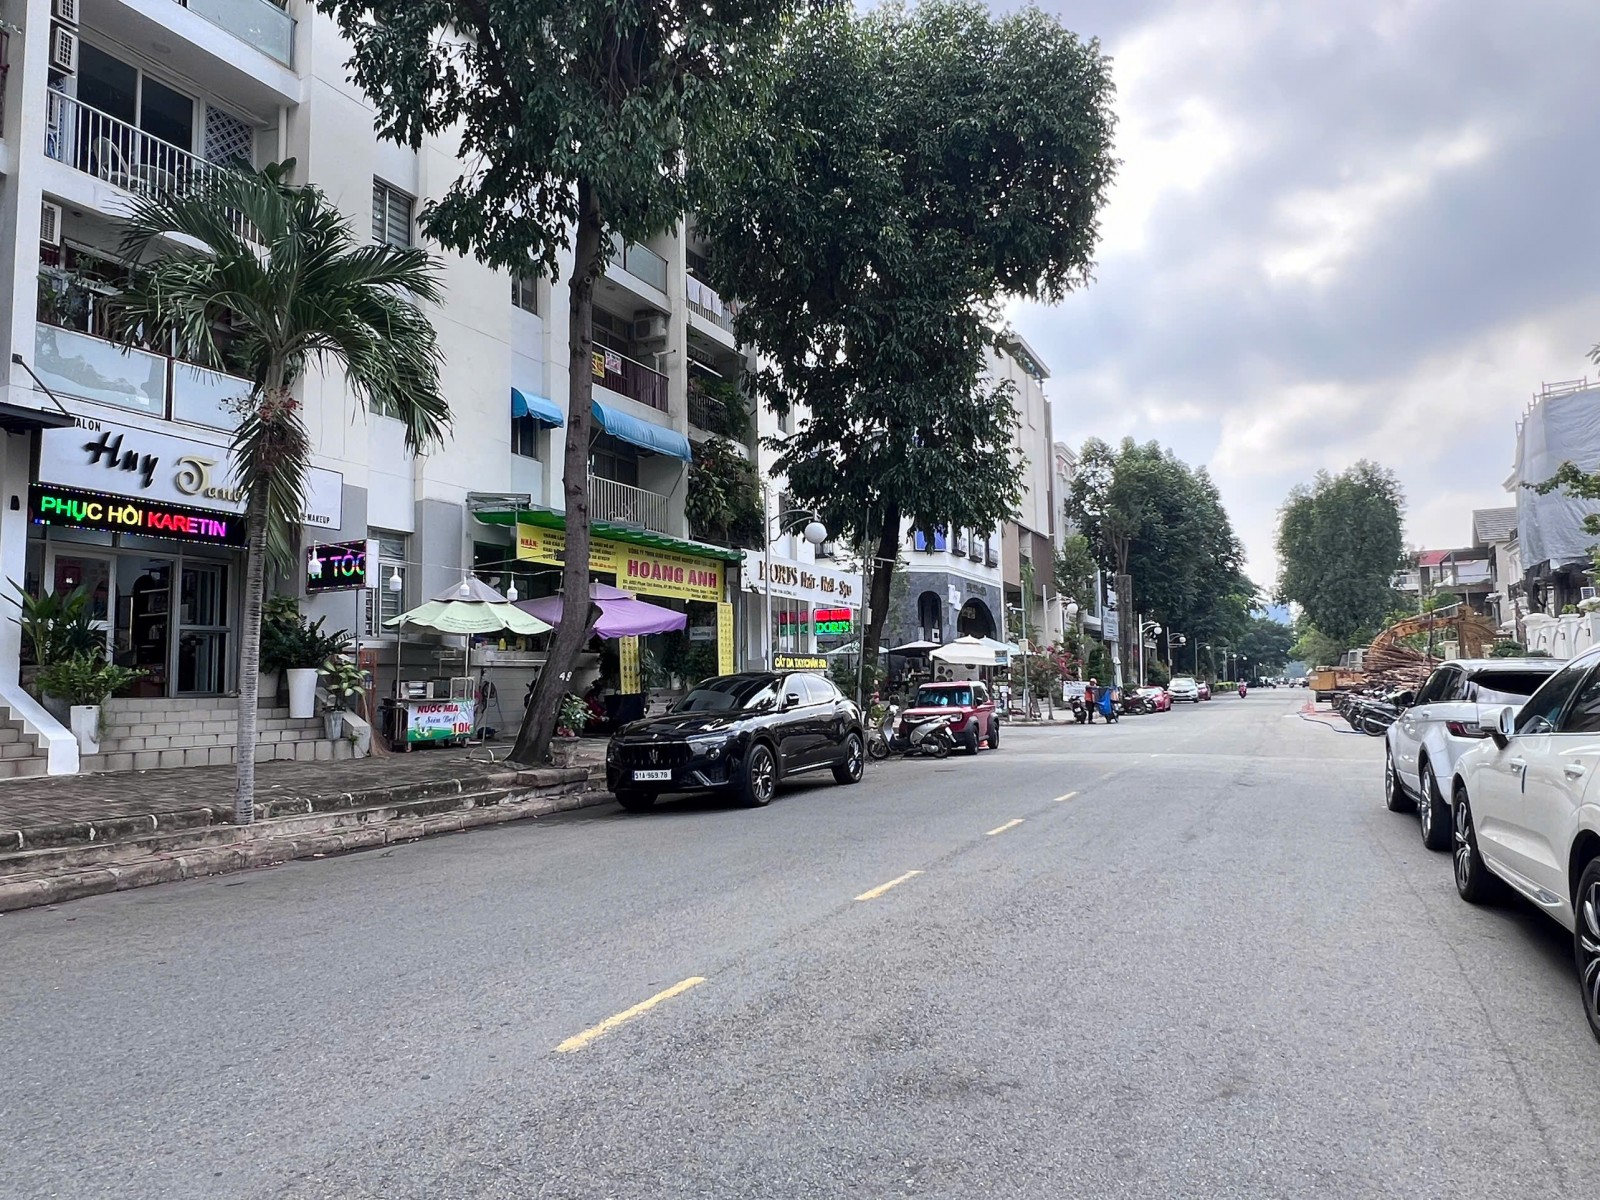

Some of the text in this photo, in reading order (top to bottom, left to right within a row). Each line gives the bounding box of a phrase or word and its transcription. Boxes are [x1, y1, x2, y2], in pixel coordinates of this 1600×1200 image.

[75, 418, 101, 432] ALON
[82, 431, 159, 489] Huy
[41, 496, 103, 521] PHỤC
[147, 512, 227, 537] KARETIN
[627, 559, 684, 584] HOÀNG
[688, 569, 717, 589] ANH
